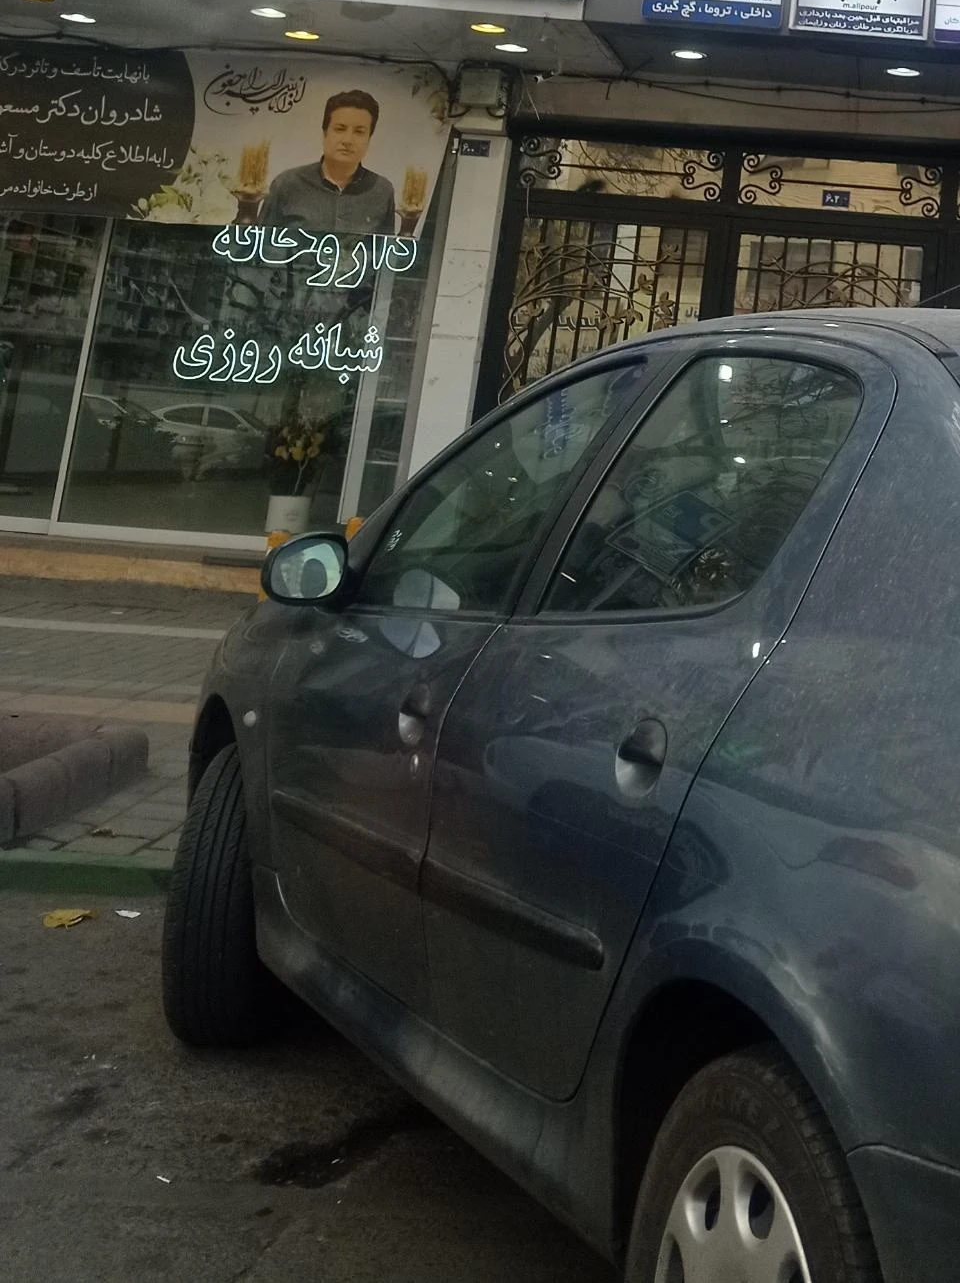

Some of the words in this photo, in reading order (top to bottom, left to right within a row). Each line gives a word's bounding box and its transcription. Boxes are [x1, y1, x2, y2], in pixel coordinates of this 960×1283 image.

[652, 0, 679, 14] گیری
[681, 0, 697, 18] گچ
[36, 89, 82, 123] دکتر
[80, 95, 162, 126] شادروان
[25, 139, 75, 161] دوستان
[76, 141, 114, 164] کلیه
[172, 327, 282, 384] روزی
[287, 322, 384, 385] شبانه
